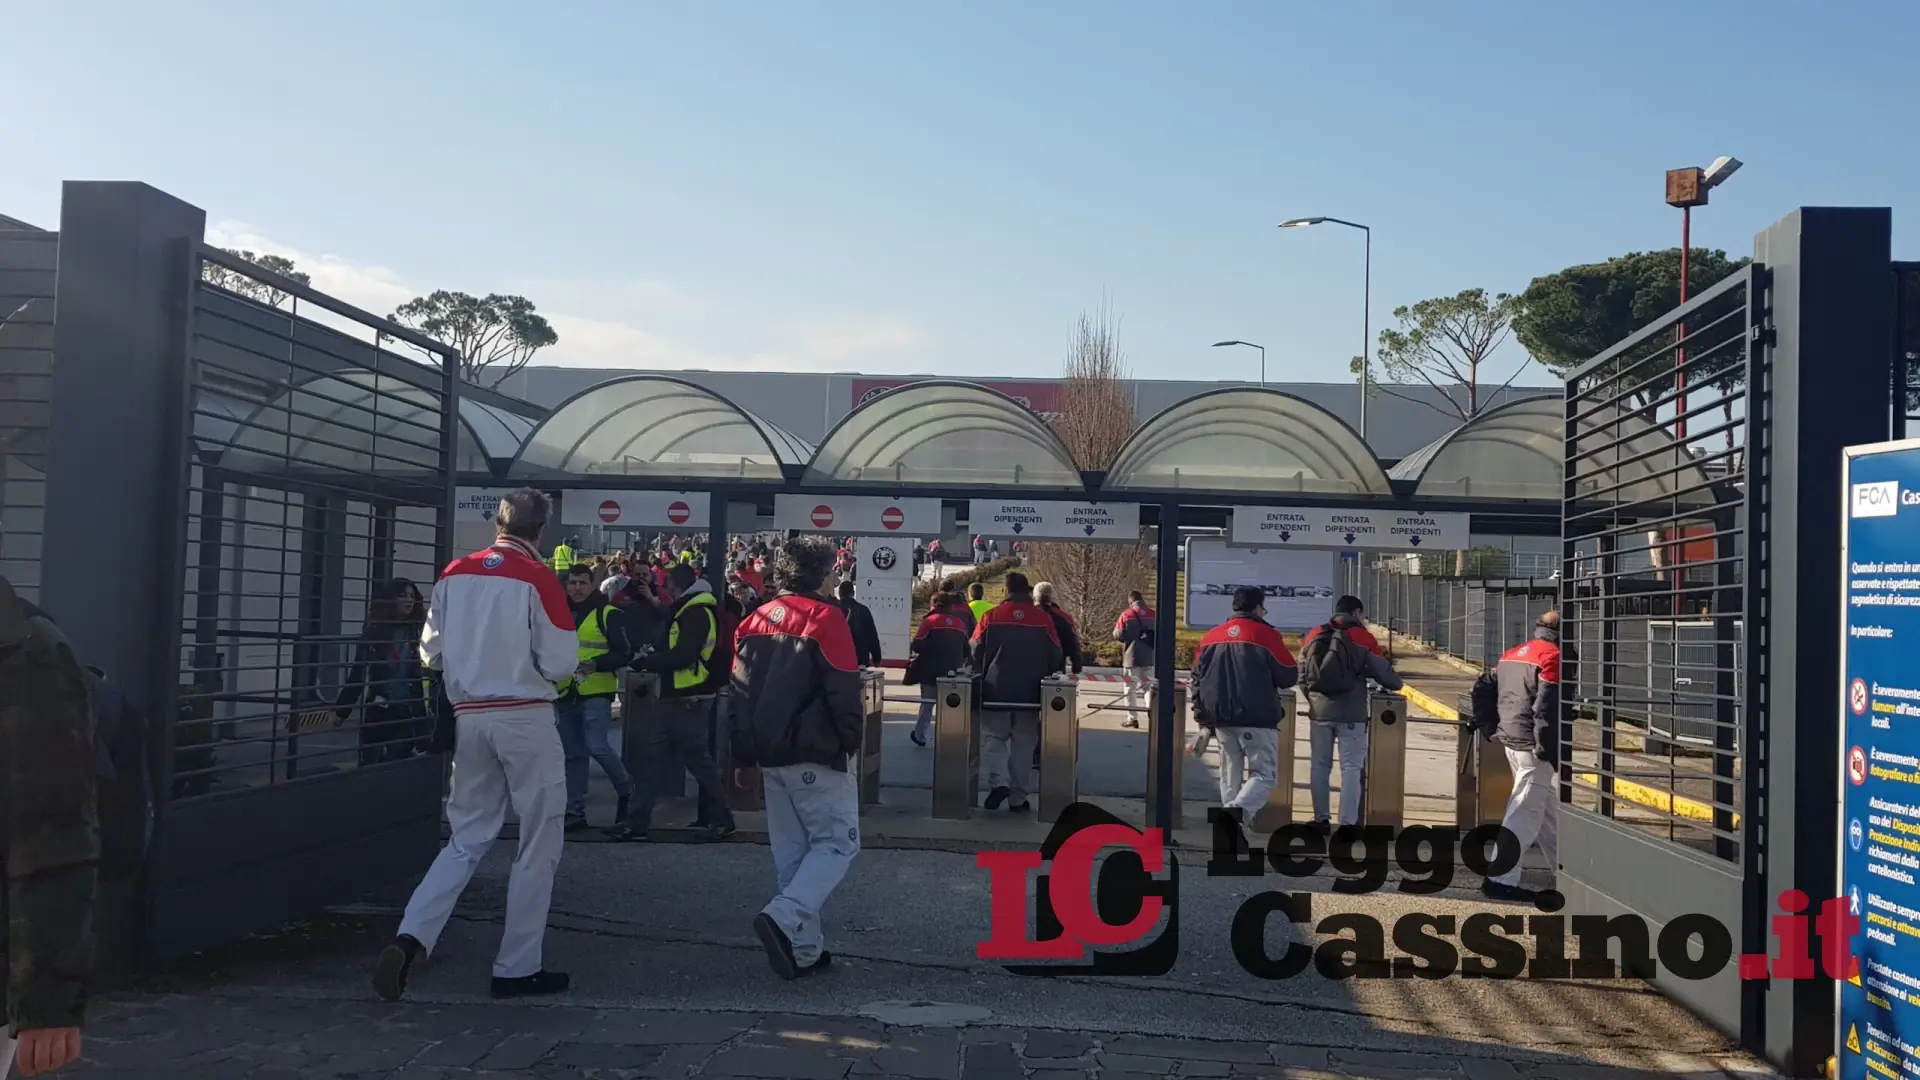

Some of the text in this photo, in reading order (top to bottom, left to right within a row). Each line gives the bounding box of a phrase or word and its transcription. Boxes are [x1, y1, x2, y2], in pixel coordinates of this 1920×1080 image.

[1858, 487, 1891, 505] FCA
[994, 515, 1042, 523] DIPENDENTI
[1066, 517, 1114, 525] DIPENDENTI
[1267, 513, 1305, 521] ENTRATA
[1331, 516, 1370, 524] ENTRATA
[1397, 517, 1436, 525] ENTRATA
[1260, 523, 1310, 531] DIPENDENTI
[1325, 525, 1376, 534] DIPENDENTI
[1390, 527, 1441, 536] DIPENDENTI
[1869, 796, 1908, 815] Assicuratevi
[1869, 814, 1880, 825] uso
[1881, 815, 1892, 827] dei
[1869, 828, 1903, 846] Protezione
[1868, 844, 1901, 864] richiamati
[1867, 957, 1892, 978] Prestate
[1867, 976, 1899, 998] attenzione
[1866, 1021, 1892, 1043] Tenetevi
